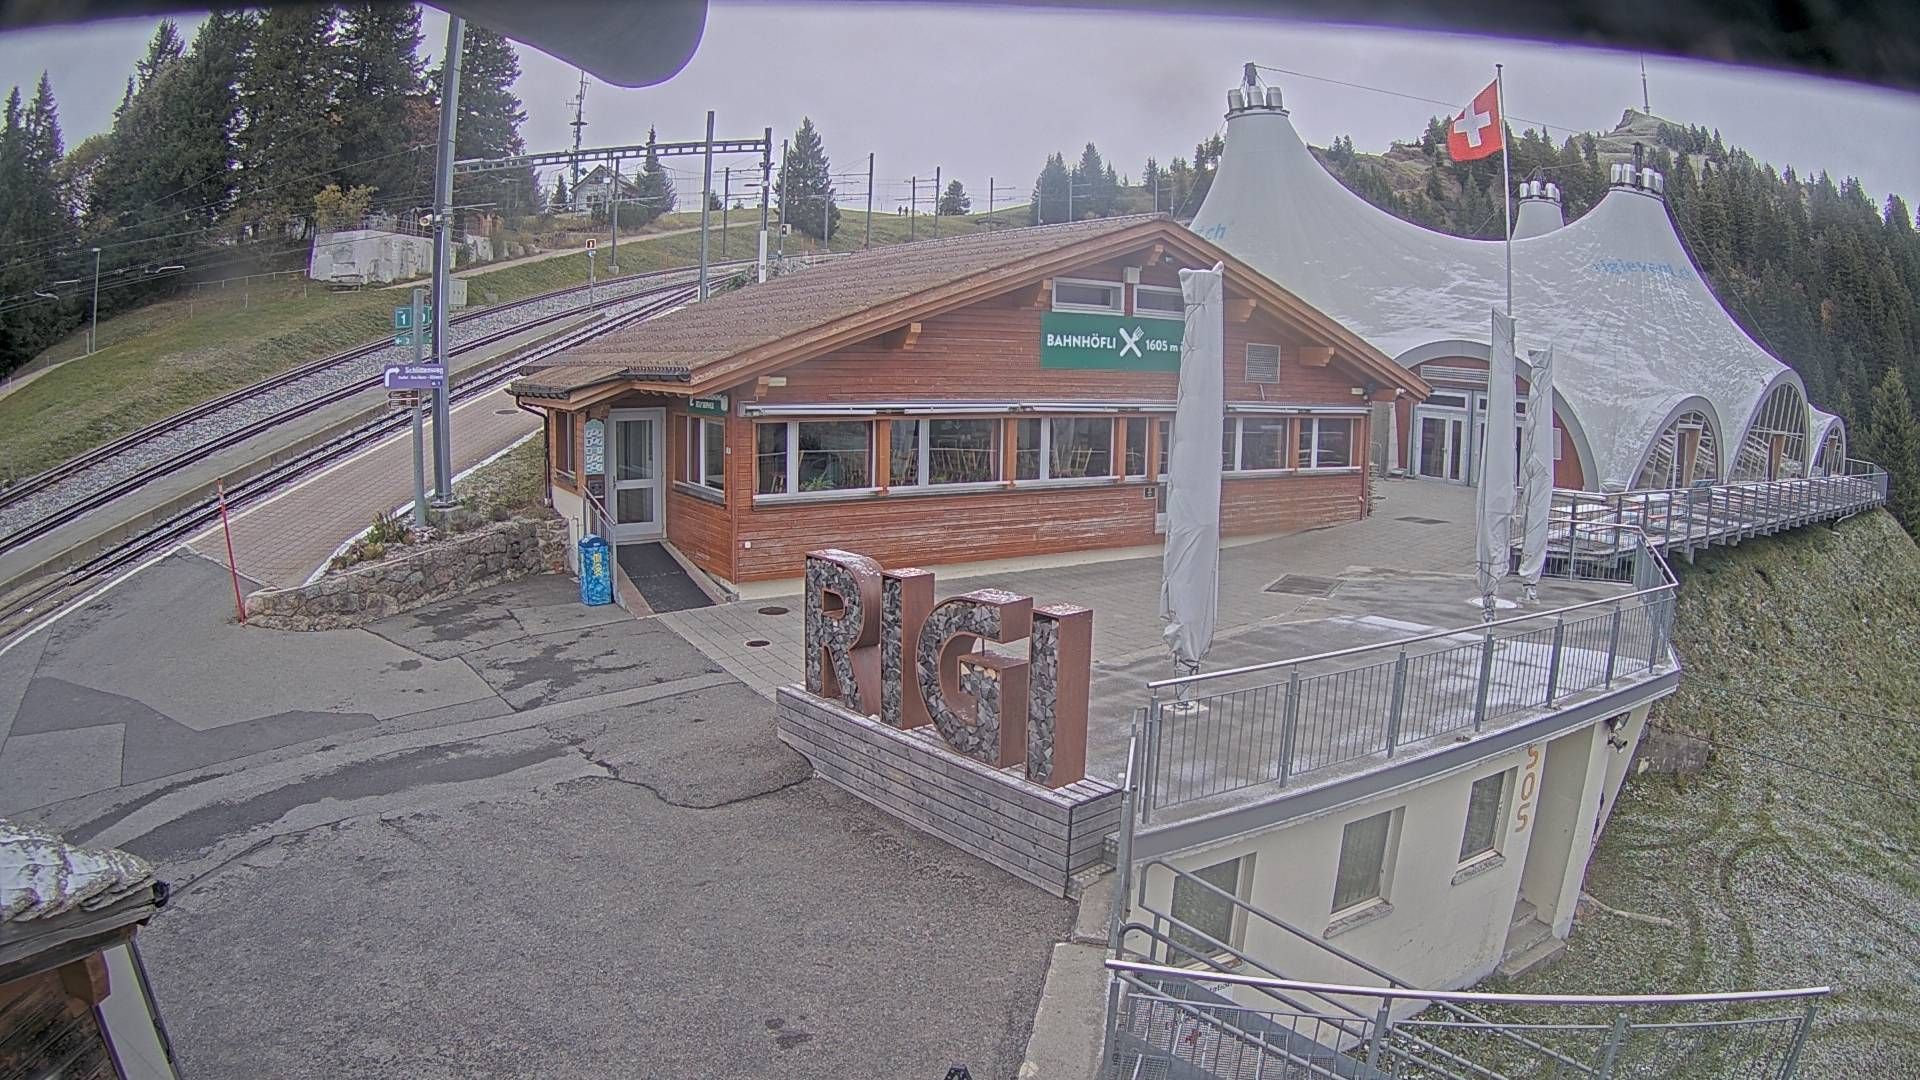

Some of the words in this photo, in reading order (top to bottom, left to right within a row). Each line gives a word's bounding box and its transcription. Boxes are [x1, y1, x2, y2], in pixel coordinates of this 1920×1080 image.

[1046, 333, 1117, 349] BAHNHÖFLI
[1145, 340, 1168, 352] 1605
[1169, 344, 1178, 352] m
[805, 549, 1093, 790] RIGI
[1515, 744, 1538, 833] SOS
